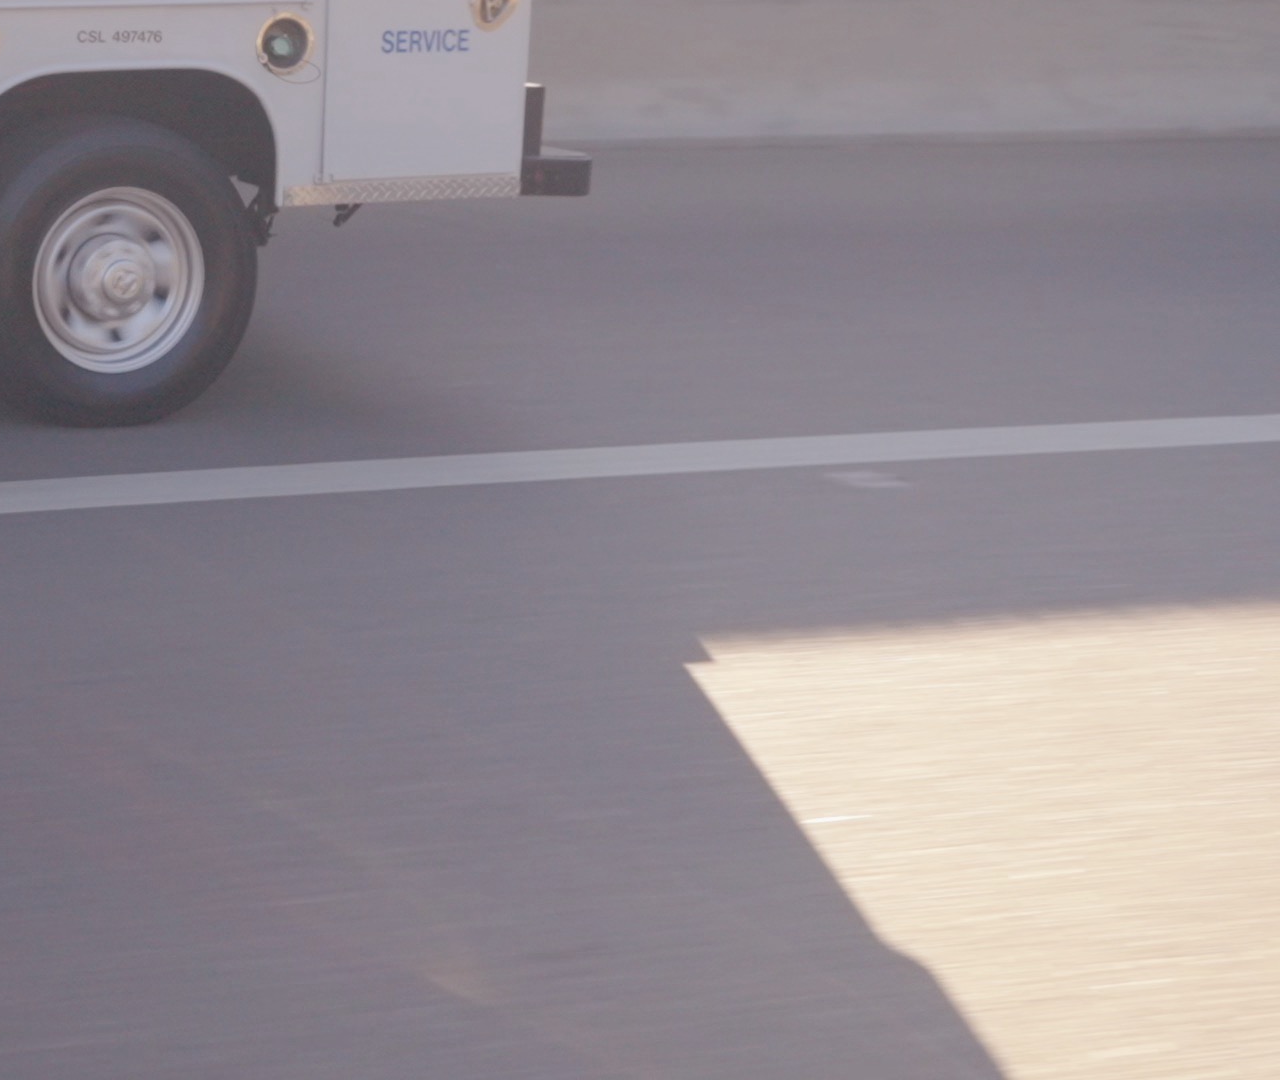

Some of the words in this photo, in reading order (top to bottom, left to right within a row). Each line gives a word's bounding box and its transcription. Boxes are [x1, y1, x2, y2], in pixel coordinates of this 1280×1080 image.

[77, 30, 106, 43] CSL
[112, 30, 163, 43] 497476
[381, 29, 470, 54] SERVICE
